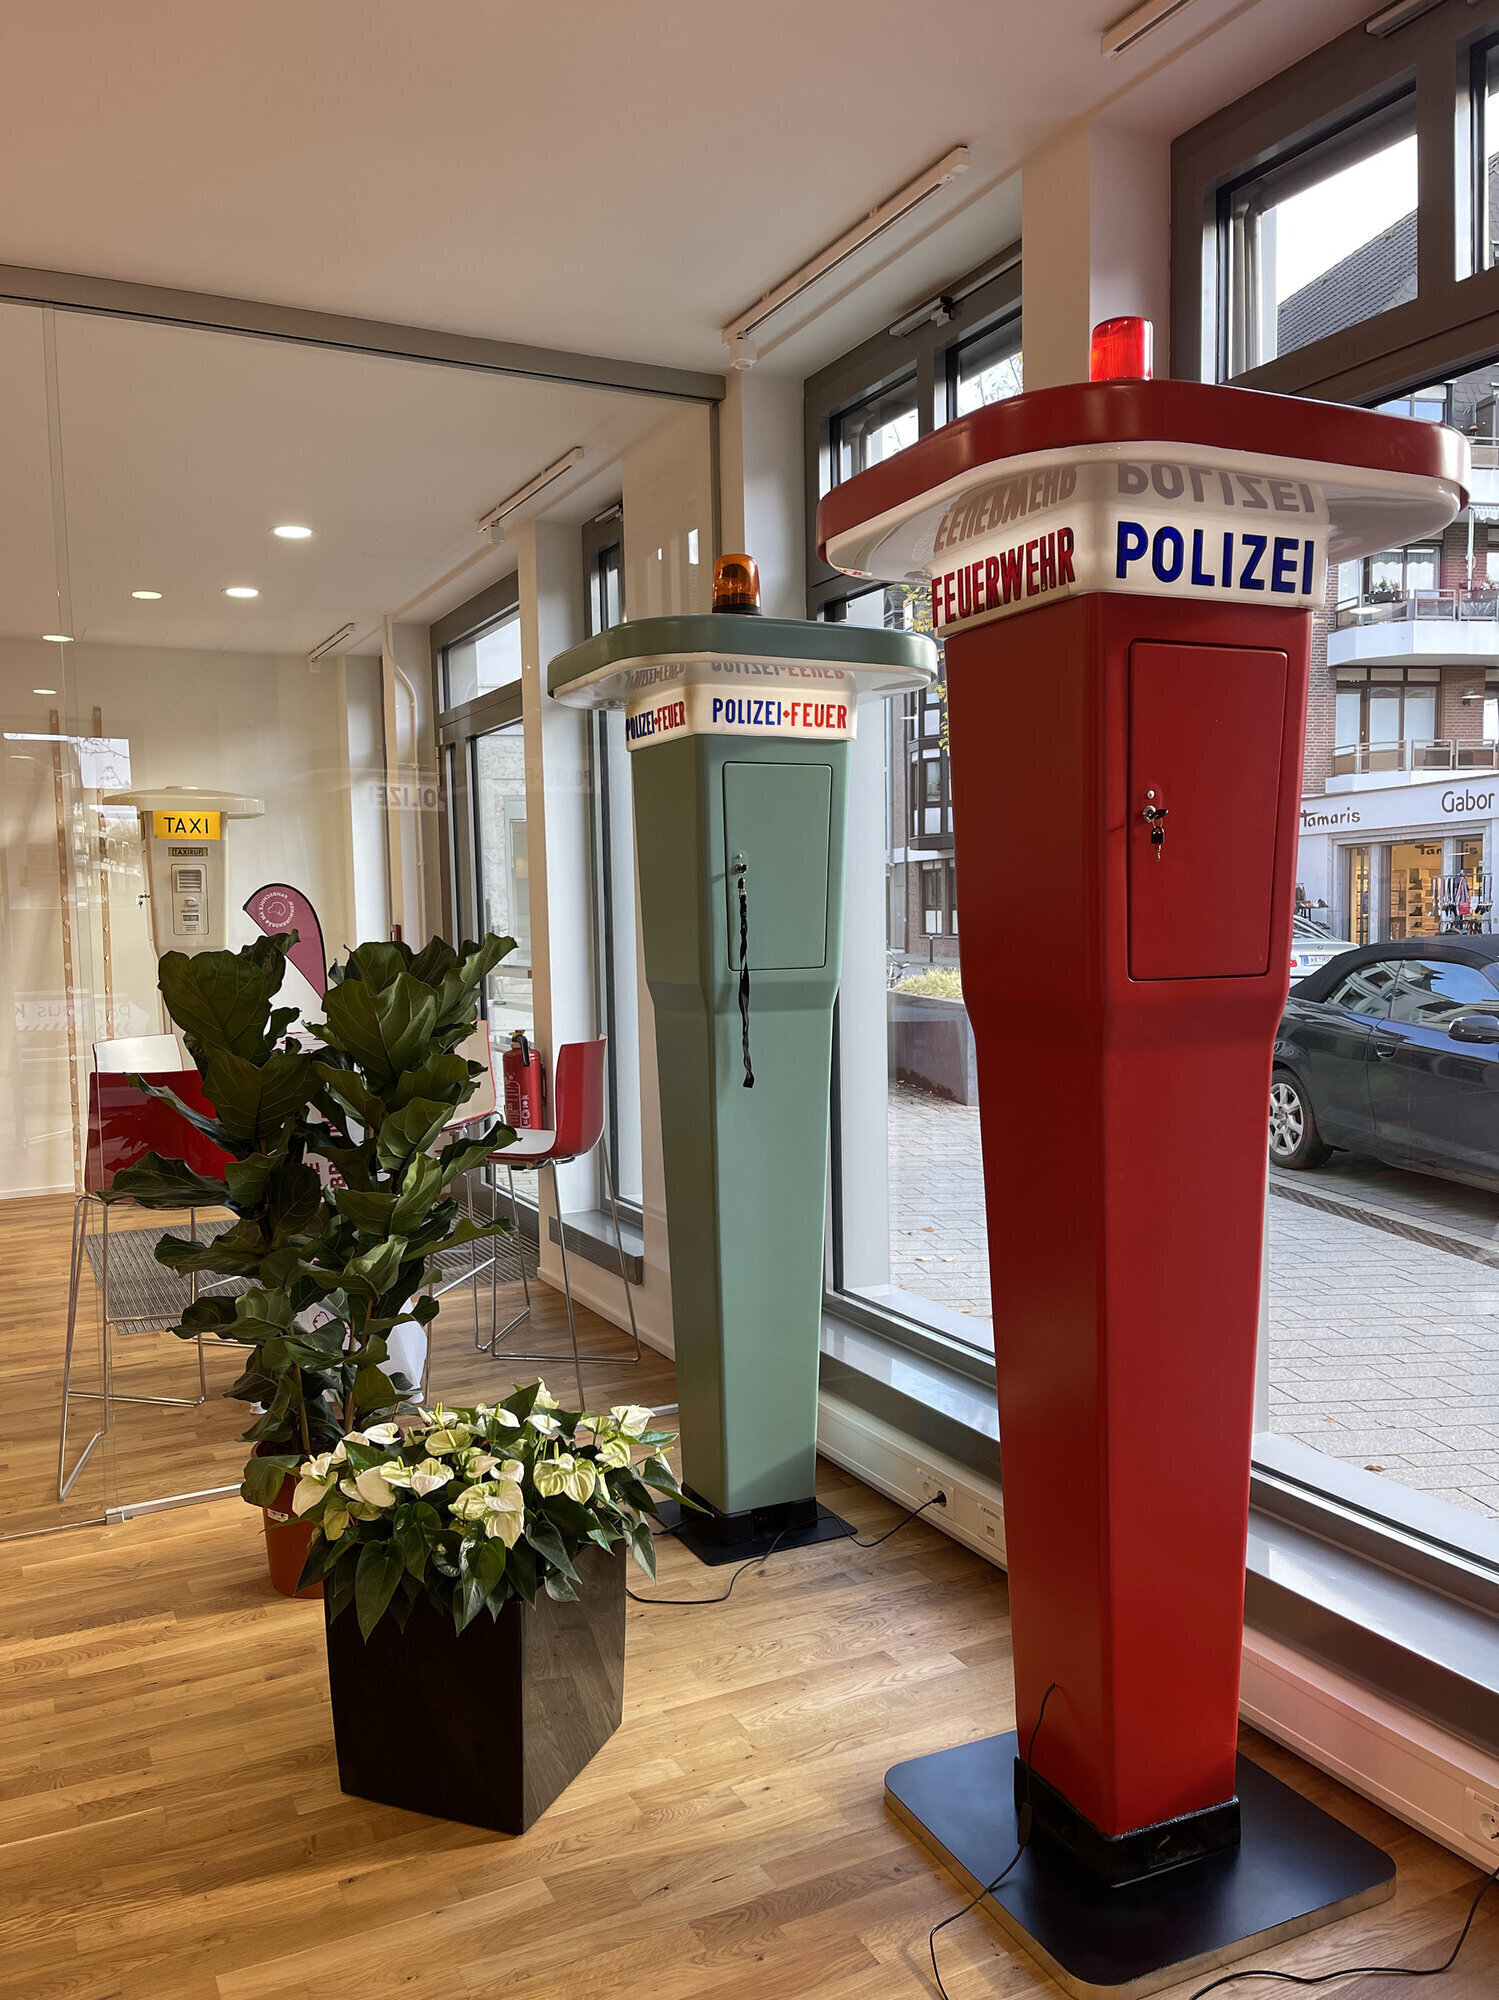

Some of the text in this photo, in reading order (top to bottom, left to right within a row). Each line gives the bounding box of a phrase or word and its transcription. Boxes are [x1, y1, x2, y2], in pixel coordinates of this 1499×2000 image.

[1116, 520, 1315, 595] POLIZEI
[931, 527, 1076, 628] FEUERWEHR
[1441, 789, 1496, 813] Gabor
[163, 816, 209, 834] TAXI
[1300, 806, 1361, 828] Tamaris
